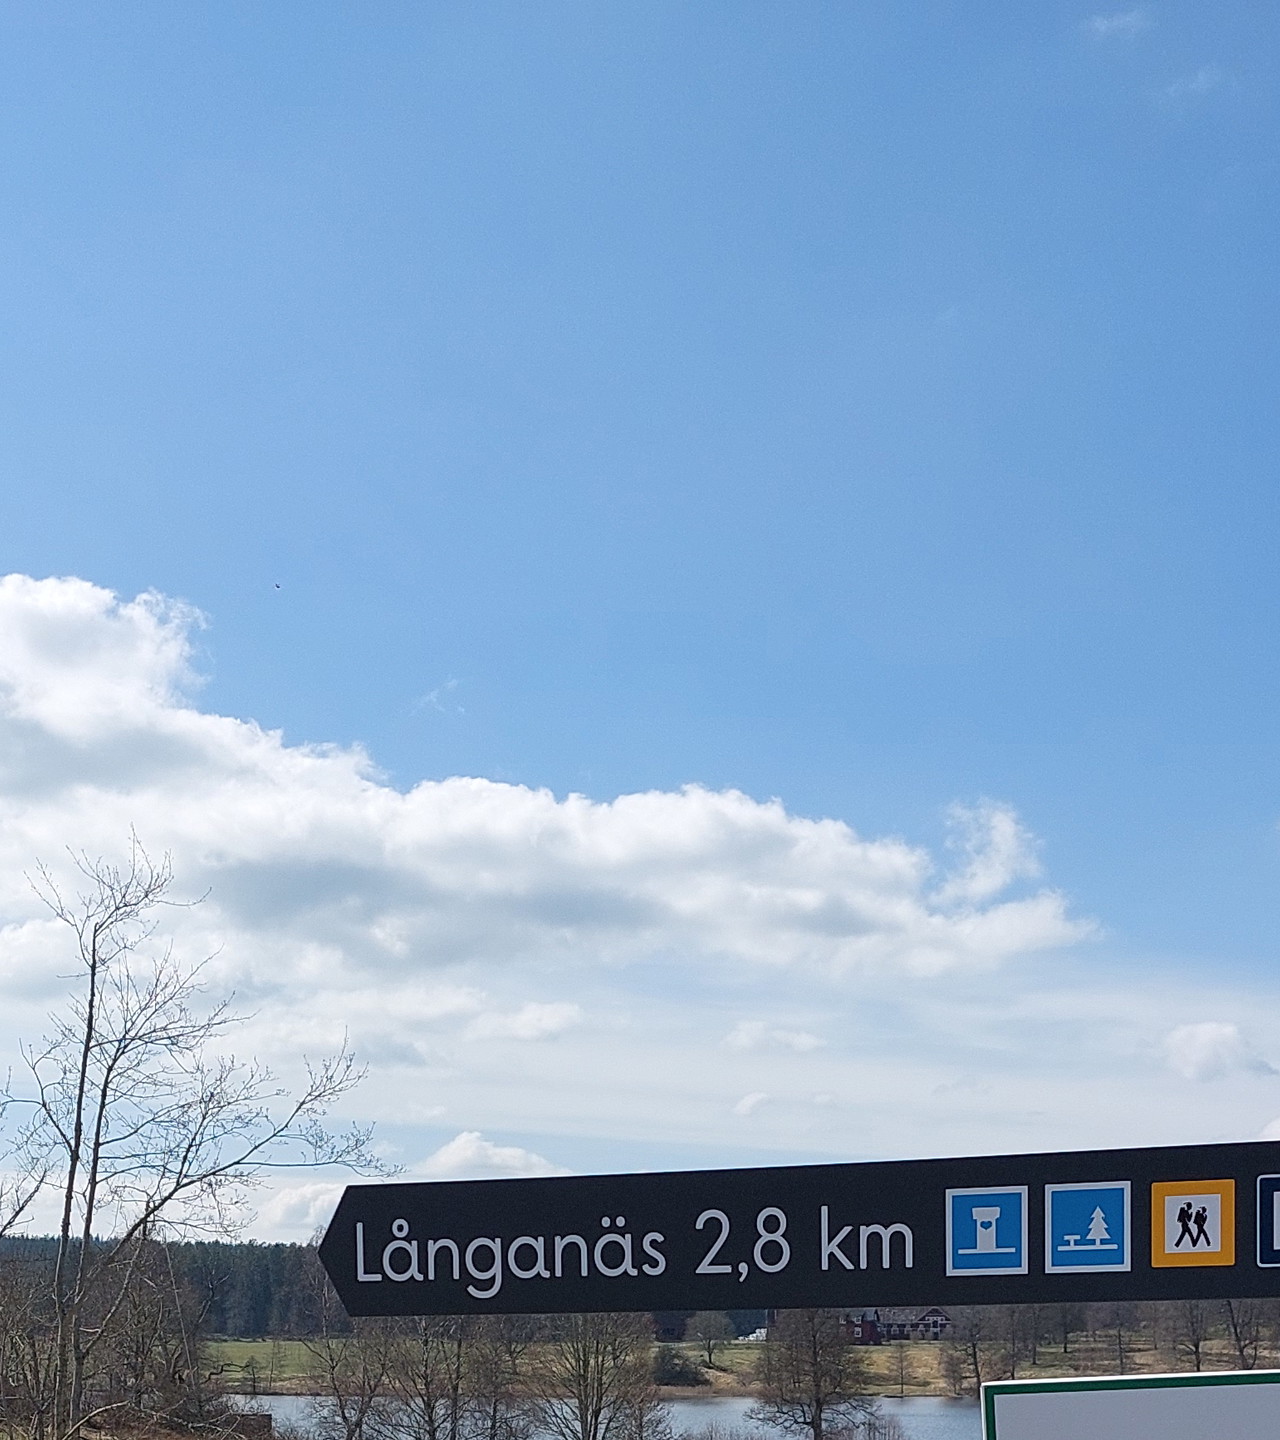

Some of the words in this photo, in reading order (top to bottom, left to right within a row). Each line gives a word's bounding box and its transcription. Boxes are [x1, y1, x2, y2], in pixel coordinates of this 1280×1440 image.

[355, 1215, 666, 1299] Långanäs
[694, 1206, 791, 1283] 2,8
[819, 1204, 914, 1271] km
